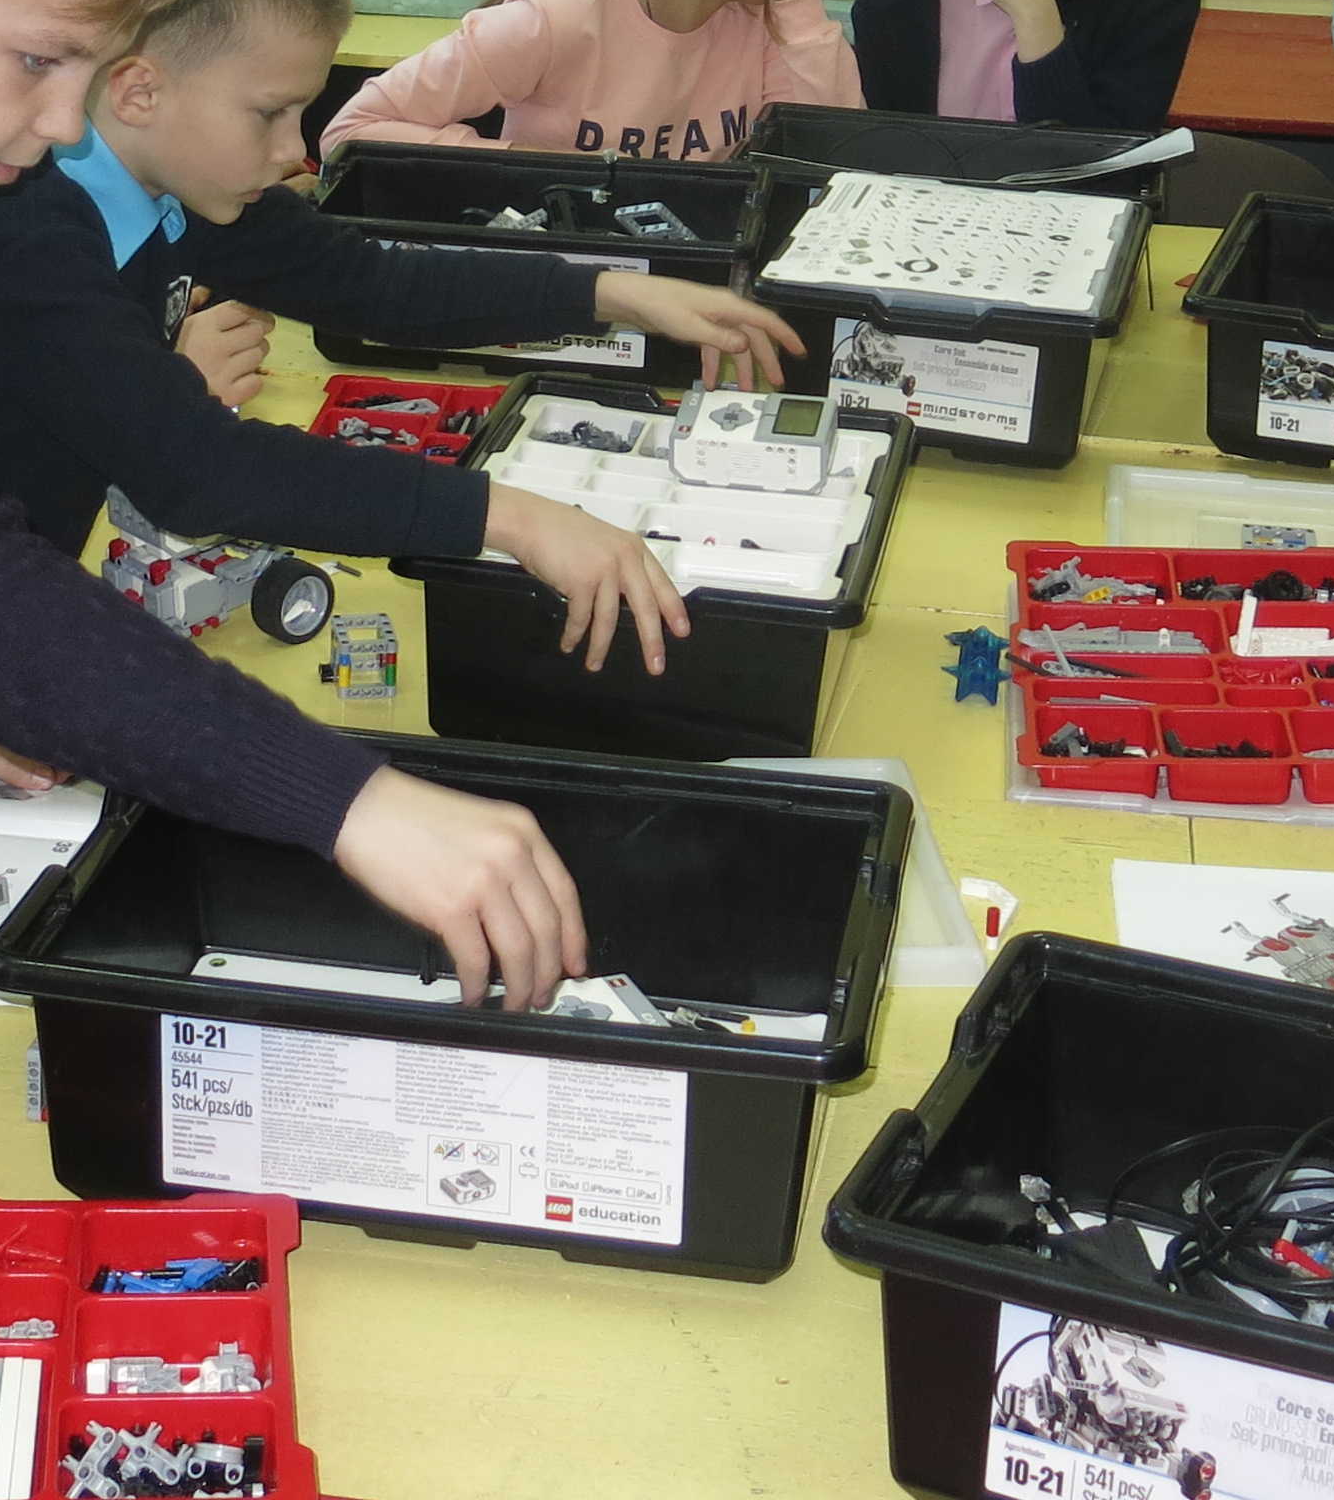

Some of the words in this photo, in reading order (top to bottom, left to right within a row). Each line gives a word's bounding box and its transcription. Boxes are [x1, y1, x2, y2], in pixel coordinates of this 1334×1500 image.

[575, 104, 747, 160] DREAM
[839, 392, 870, 409] 10-21
[1269, 415, 1300, 433] 10-21
[172, 1022, 227, 1049] 10-21
[171, 1050, 203, 1065] 45544
[171, 1068, 198, 1090] 541
[203, 1077, 233, 1096] pcs/
[172, 1093, 253, 1118] Stck/pzs/db
[558, 1180, 579, 1190] iPod
[590, 1184, 623, 1196] iPhone
[636, 1189, 657, 1200] iPad
[547, 1202, 571, 1215] LEGO
[578, 1206, 662, 1226] education
[1276, 1396, 1313, 1420] Core
[1231, 1421, 1258, 1445] Set
[1261, 1431, 1329, 1465] principal
[1003, 1455, 1064, 1497] 10-21
[1084, 1463, 1115, 1492] 541
[1118, 1479, 1154, 1500] pcs/
